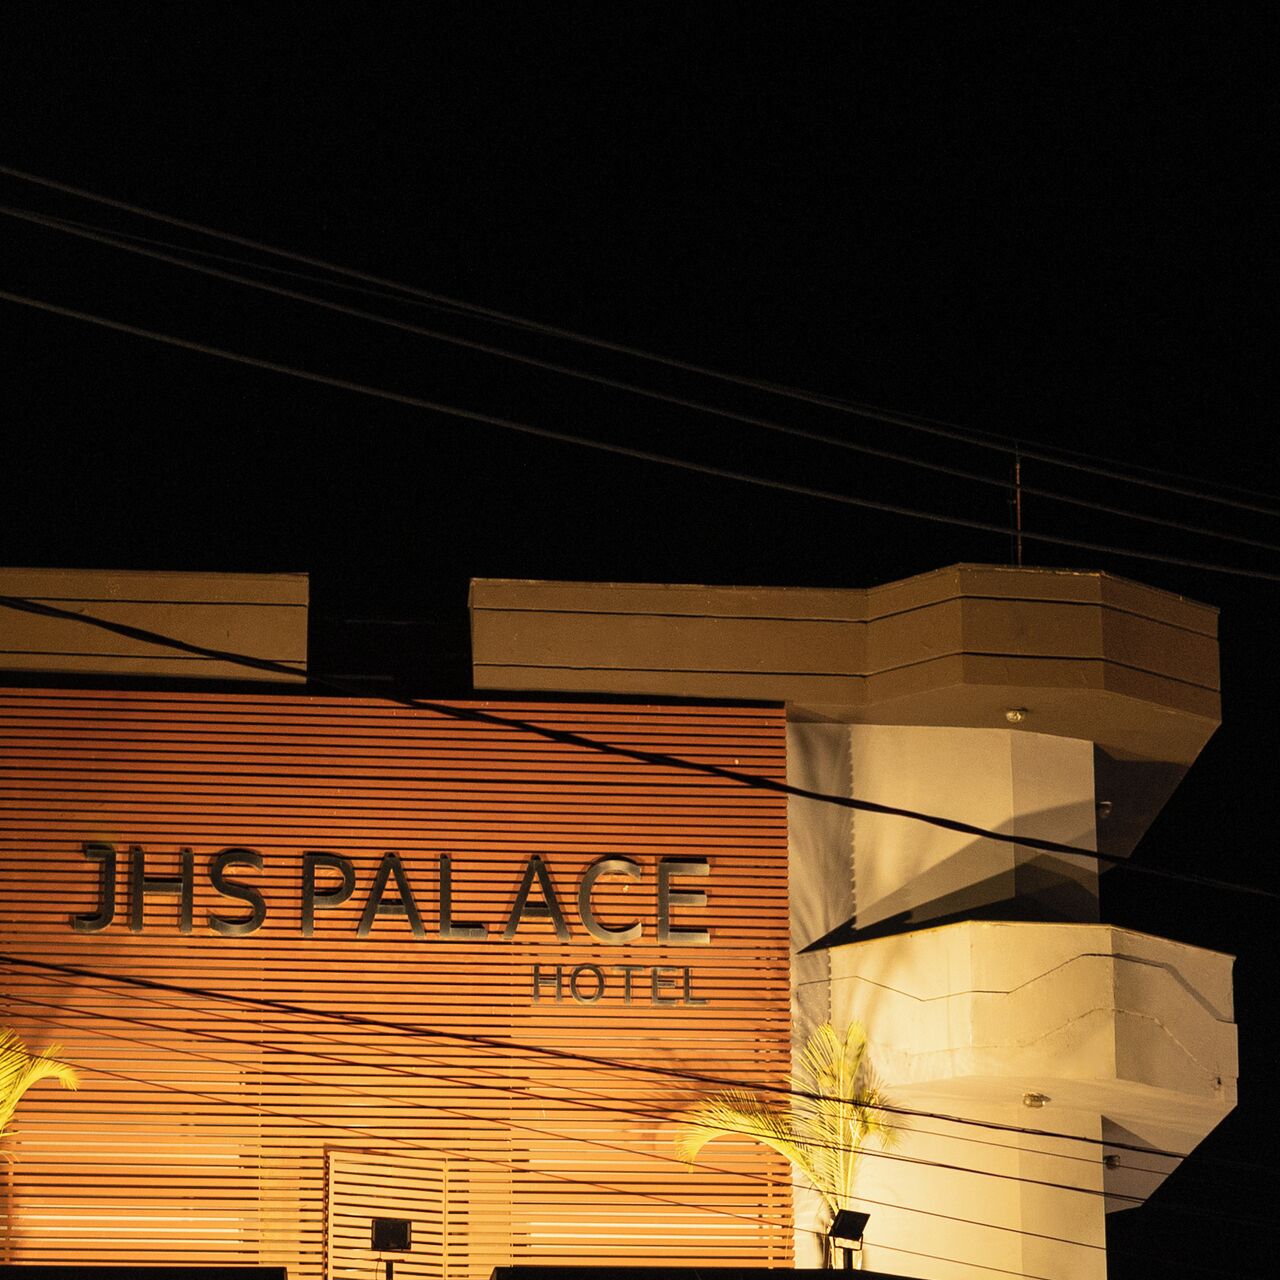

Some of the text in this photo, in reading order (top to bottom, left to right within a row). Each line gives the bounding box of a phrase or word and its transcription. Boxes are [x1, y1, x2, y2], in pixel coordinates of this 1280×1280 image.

[72, 843, 711, 944] JHS PALACE
[532, 964, 709, 1005] HOTEL
